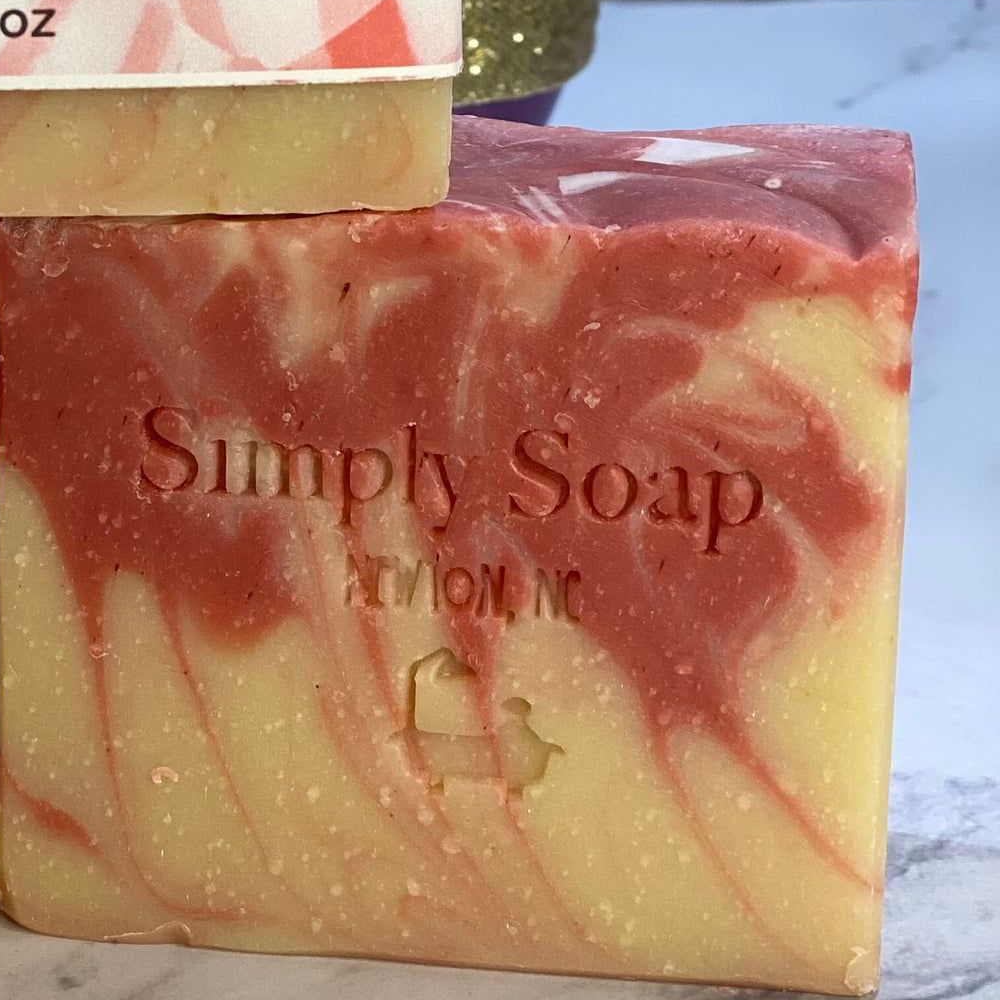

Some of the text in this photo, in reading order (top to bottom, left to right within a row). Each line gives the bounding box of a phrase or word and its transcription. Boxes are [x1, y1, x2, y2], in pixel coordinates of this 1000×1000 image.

[0, 8, 56, 39] oz
[137, 404, 767, 556] Simply Soap
